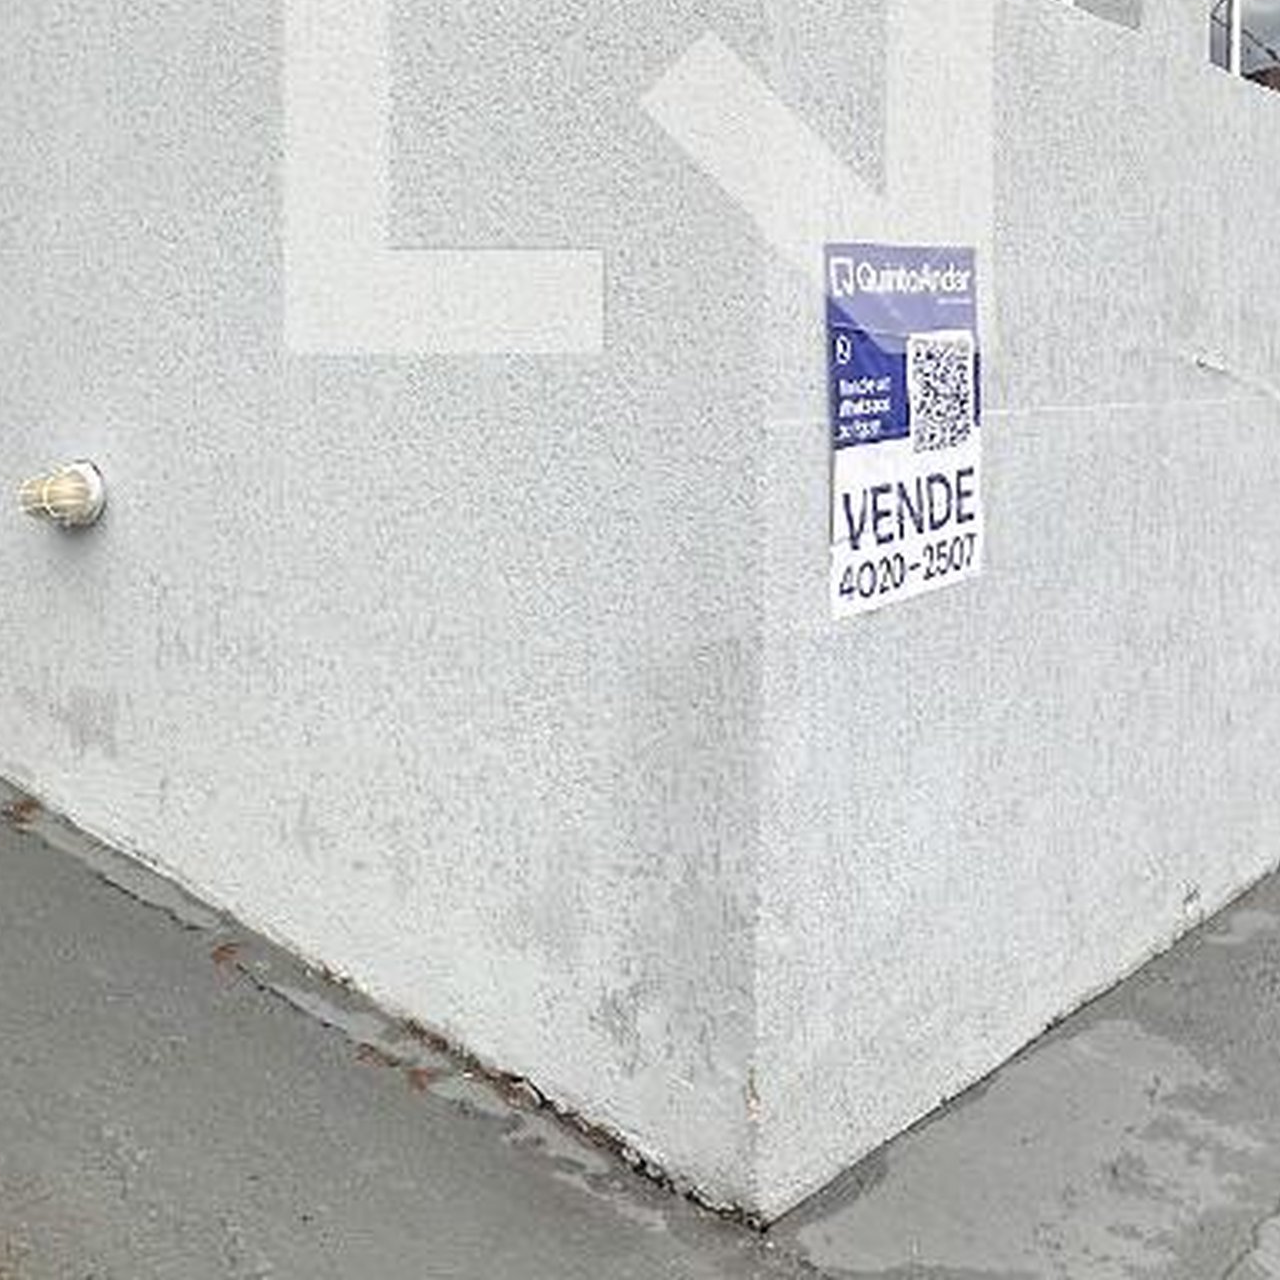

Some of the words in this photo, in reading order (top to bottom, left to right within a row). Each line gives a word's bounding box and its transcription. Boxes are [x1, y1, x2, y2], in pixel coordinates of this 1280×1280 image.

[855, 261, 971, 293] QuintoAndar
[842, 466, 975, 552] VENDE
[839, 532, 978, 600] 4020-2507
